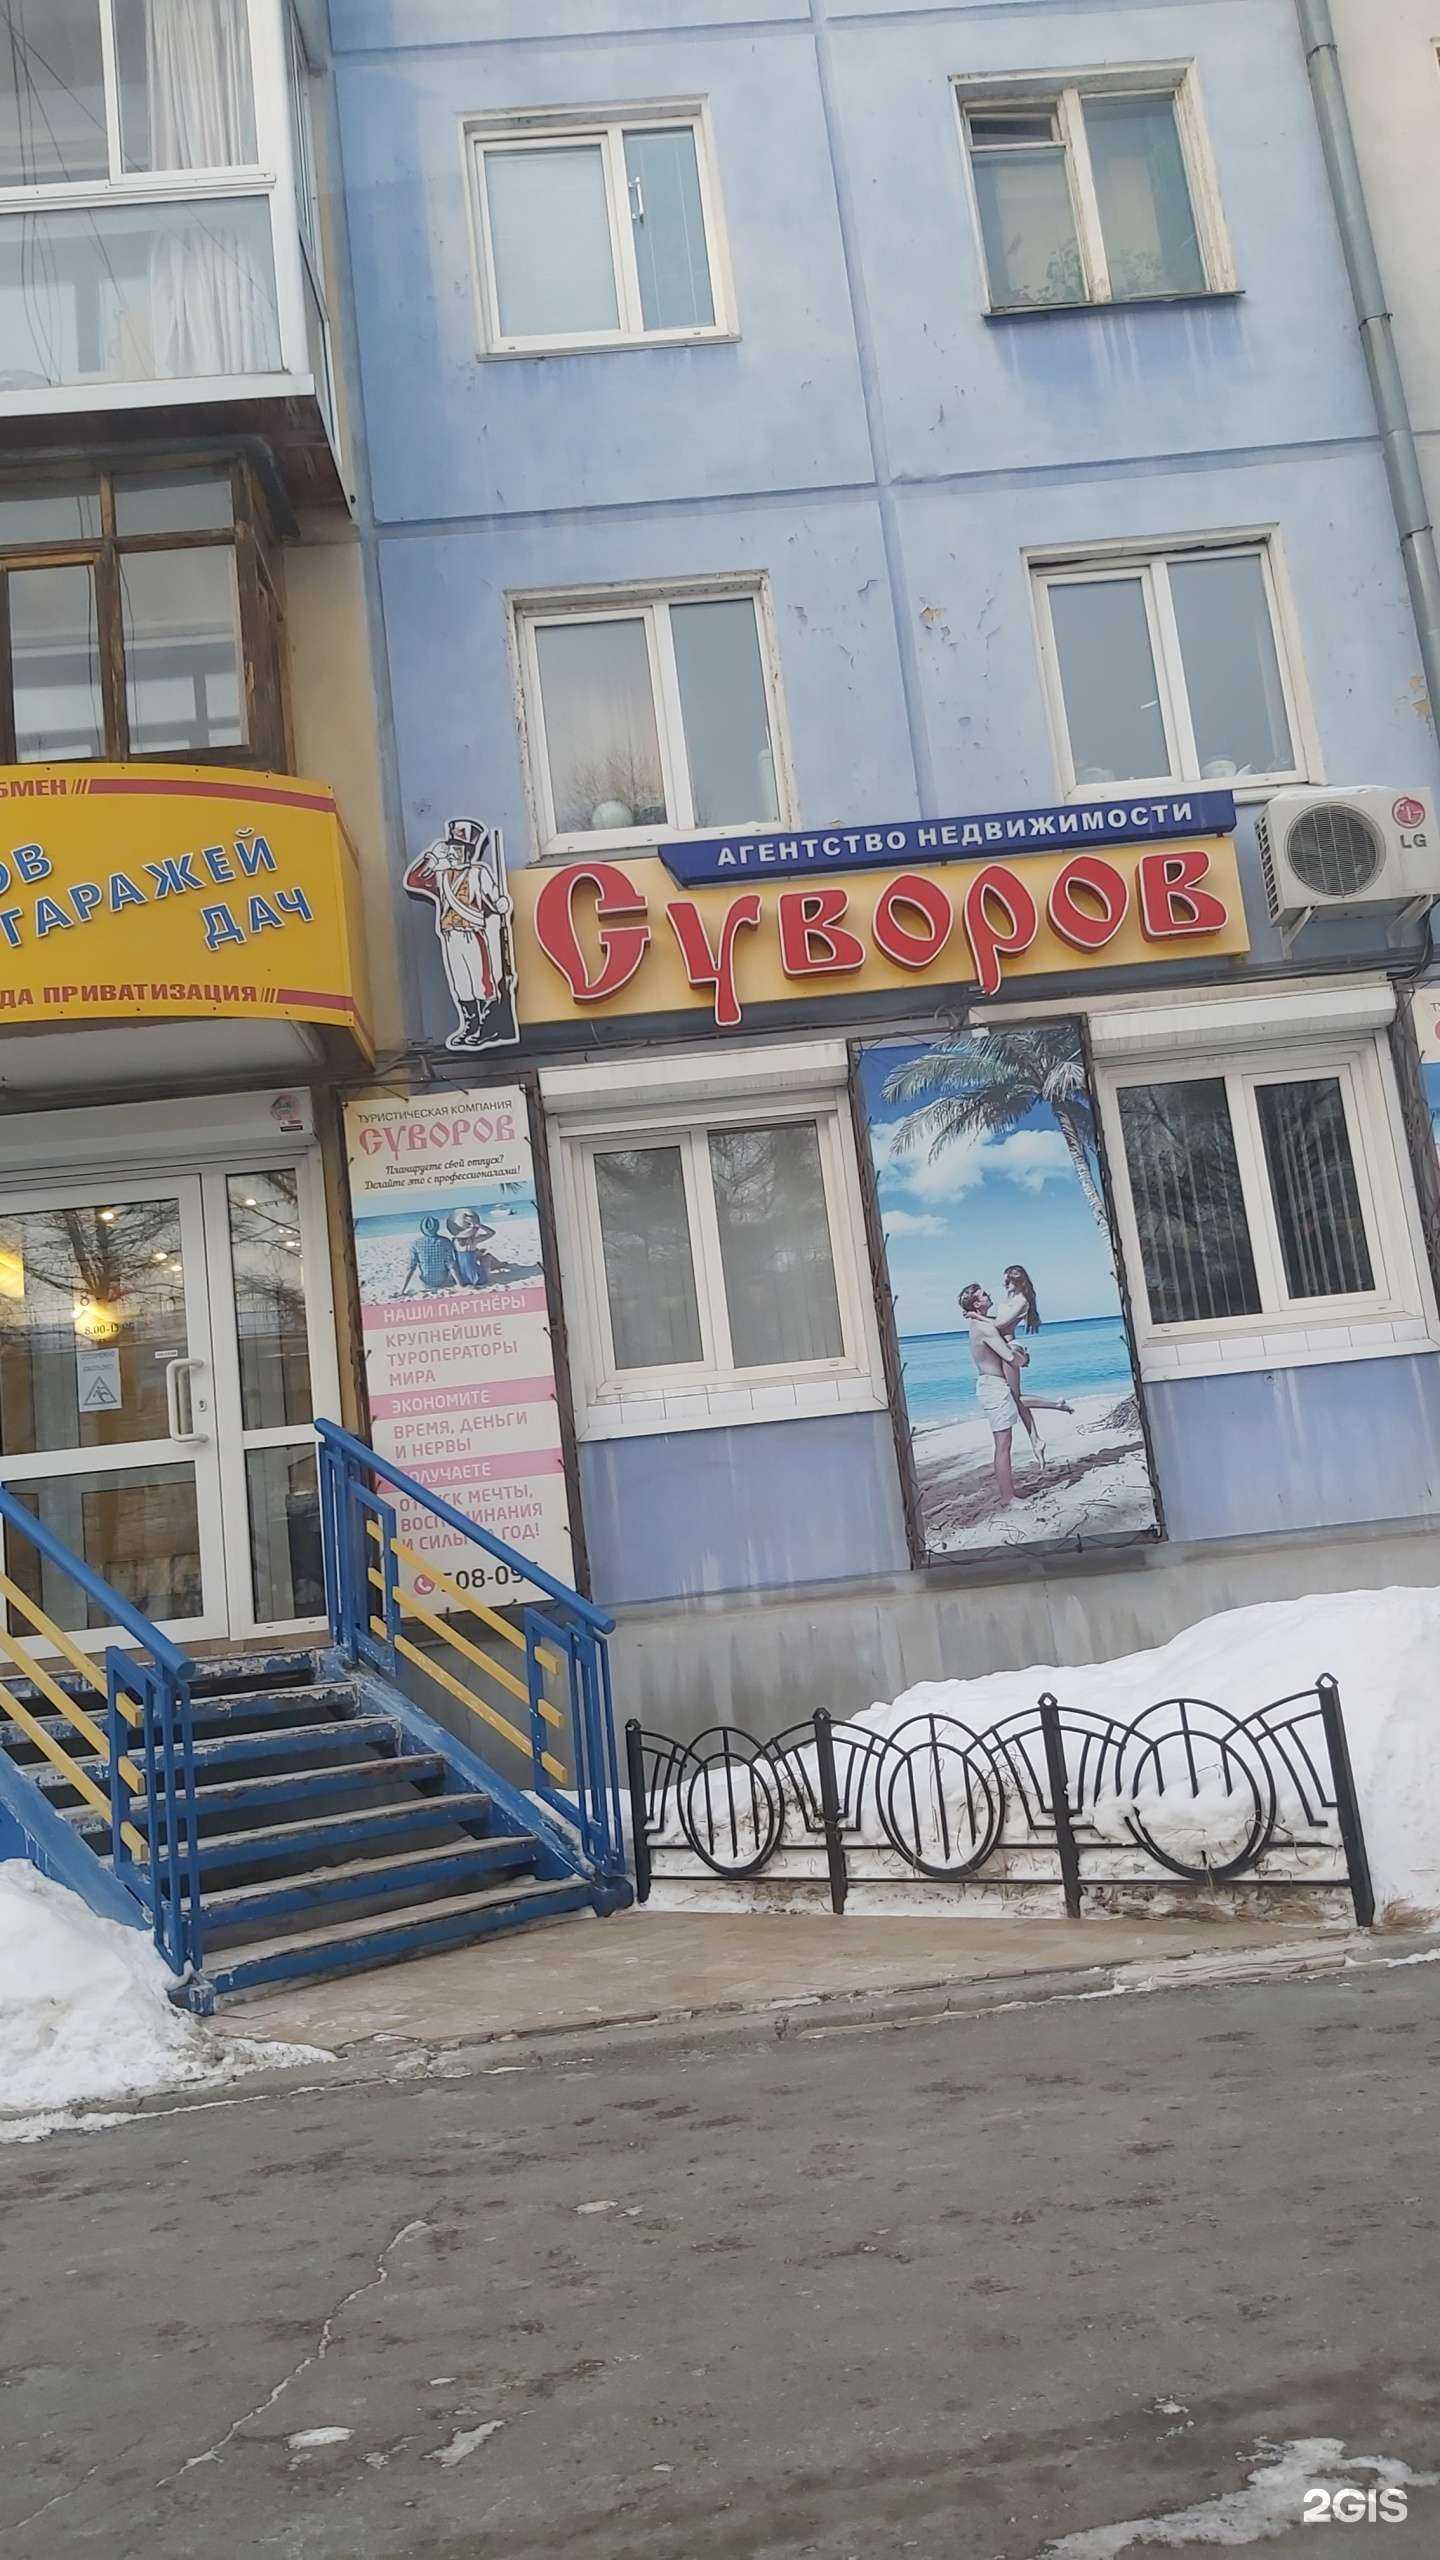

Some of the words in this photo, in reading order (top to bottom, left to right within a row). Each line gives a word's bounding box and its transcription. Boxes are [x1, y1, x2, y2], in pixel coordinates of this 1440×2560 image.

[717, 830, 907, 866] АГЕНТСТВО
[916, 802, 1194, 848] НЕДВИЖИМОСТИ
[1400, 833, 1427, 848] LG
[0, 826, 278, 947] ГАРАЖЕЙ
[200, 887, 314, 952] ДАЧ
[43, 983, 258, 1004] ПРИВАТИЗАЦИЯ
[358, 1106, 449, 1124] ТУРИСТИЧЕСКАЯ
[450, 1100, 512, 1116] КОМПАНИЯ
[385, 1161, 442, 1176] Планируете
[444, 1158, 465, 1170] свой
[467, 1154, 505, 1169] отпуск?
[364, 1177, 406, 1190] Делайте
[407, 1177, 424, 1186] это
[433, 1165, 521, 1186] профессионалами!
[383, 1305, 434, 1323] НАШИ
[385, 1322, 503, 1348] КРУПНЕЙШИЕ
[387, 1340, 518, 1367] ТУРОПЕРАТОРЫ
[389, 1369, 436, 1387] МИРА
[392, 1389, 490, 1413] ЭКОНОМИТЕ
[393, 1420, 455, 1440] ВРЕМЯ,
[460, 1410, 529, 1433] ДЕНЬГИ
[394, 1445, 407, 1459] И
[412, 1437, 471, 1458] НЕРВЫ
[410, 1462, 491, 1485] ОЛУЧАЕТЕ
[468, 1484, 534, 1502] МЕЧТЫ,
[502, 1522, 540, 1541] ГОД!
